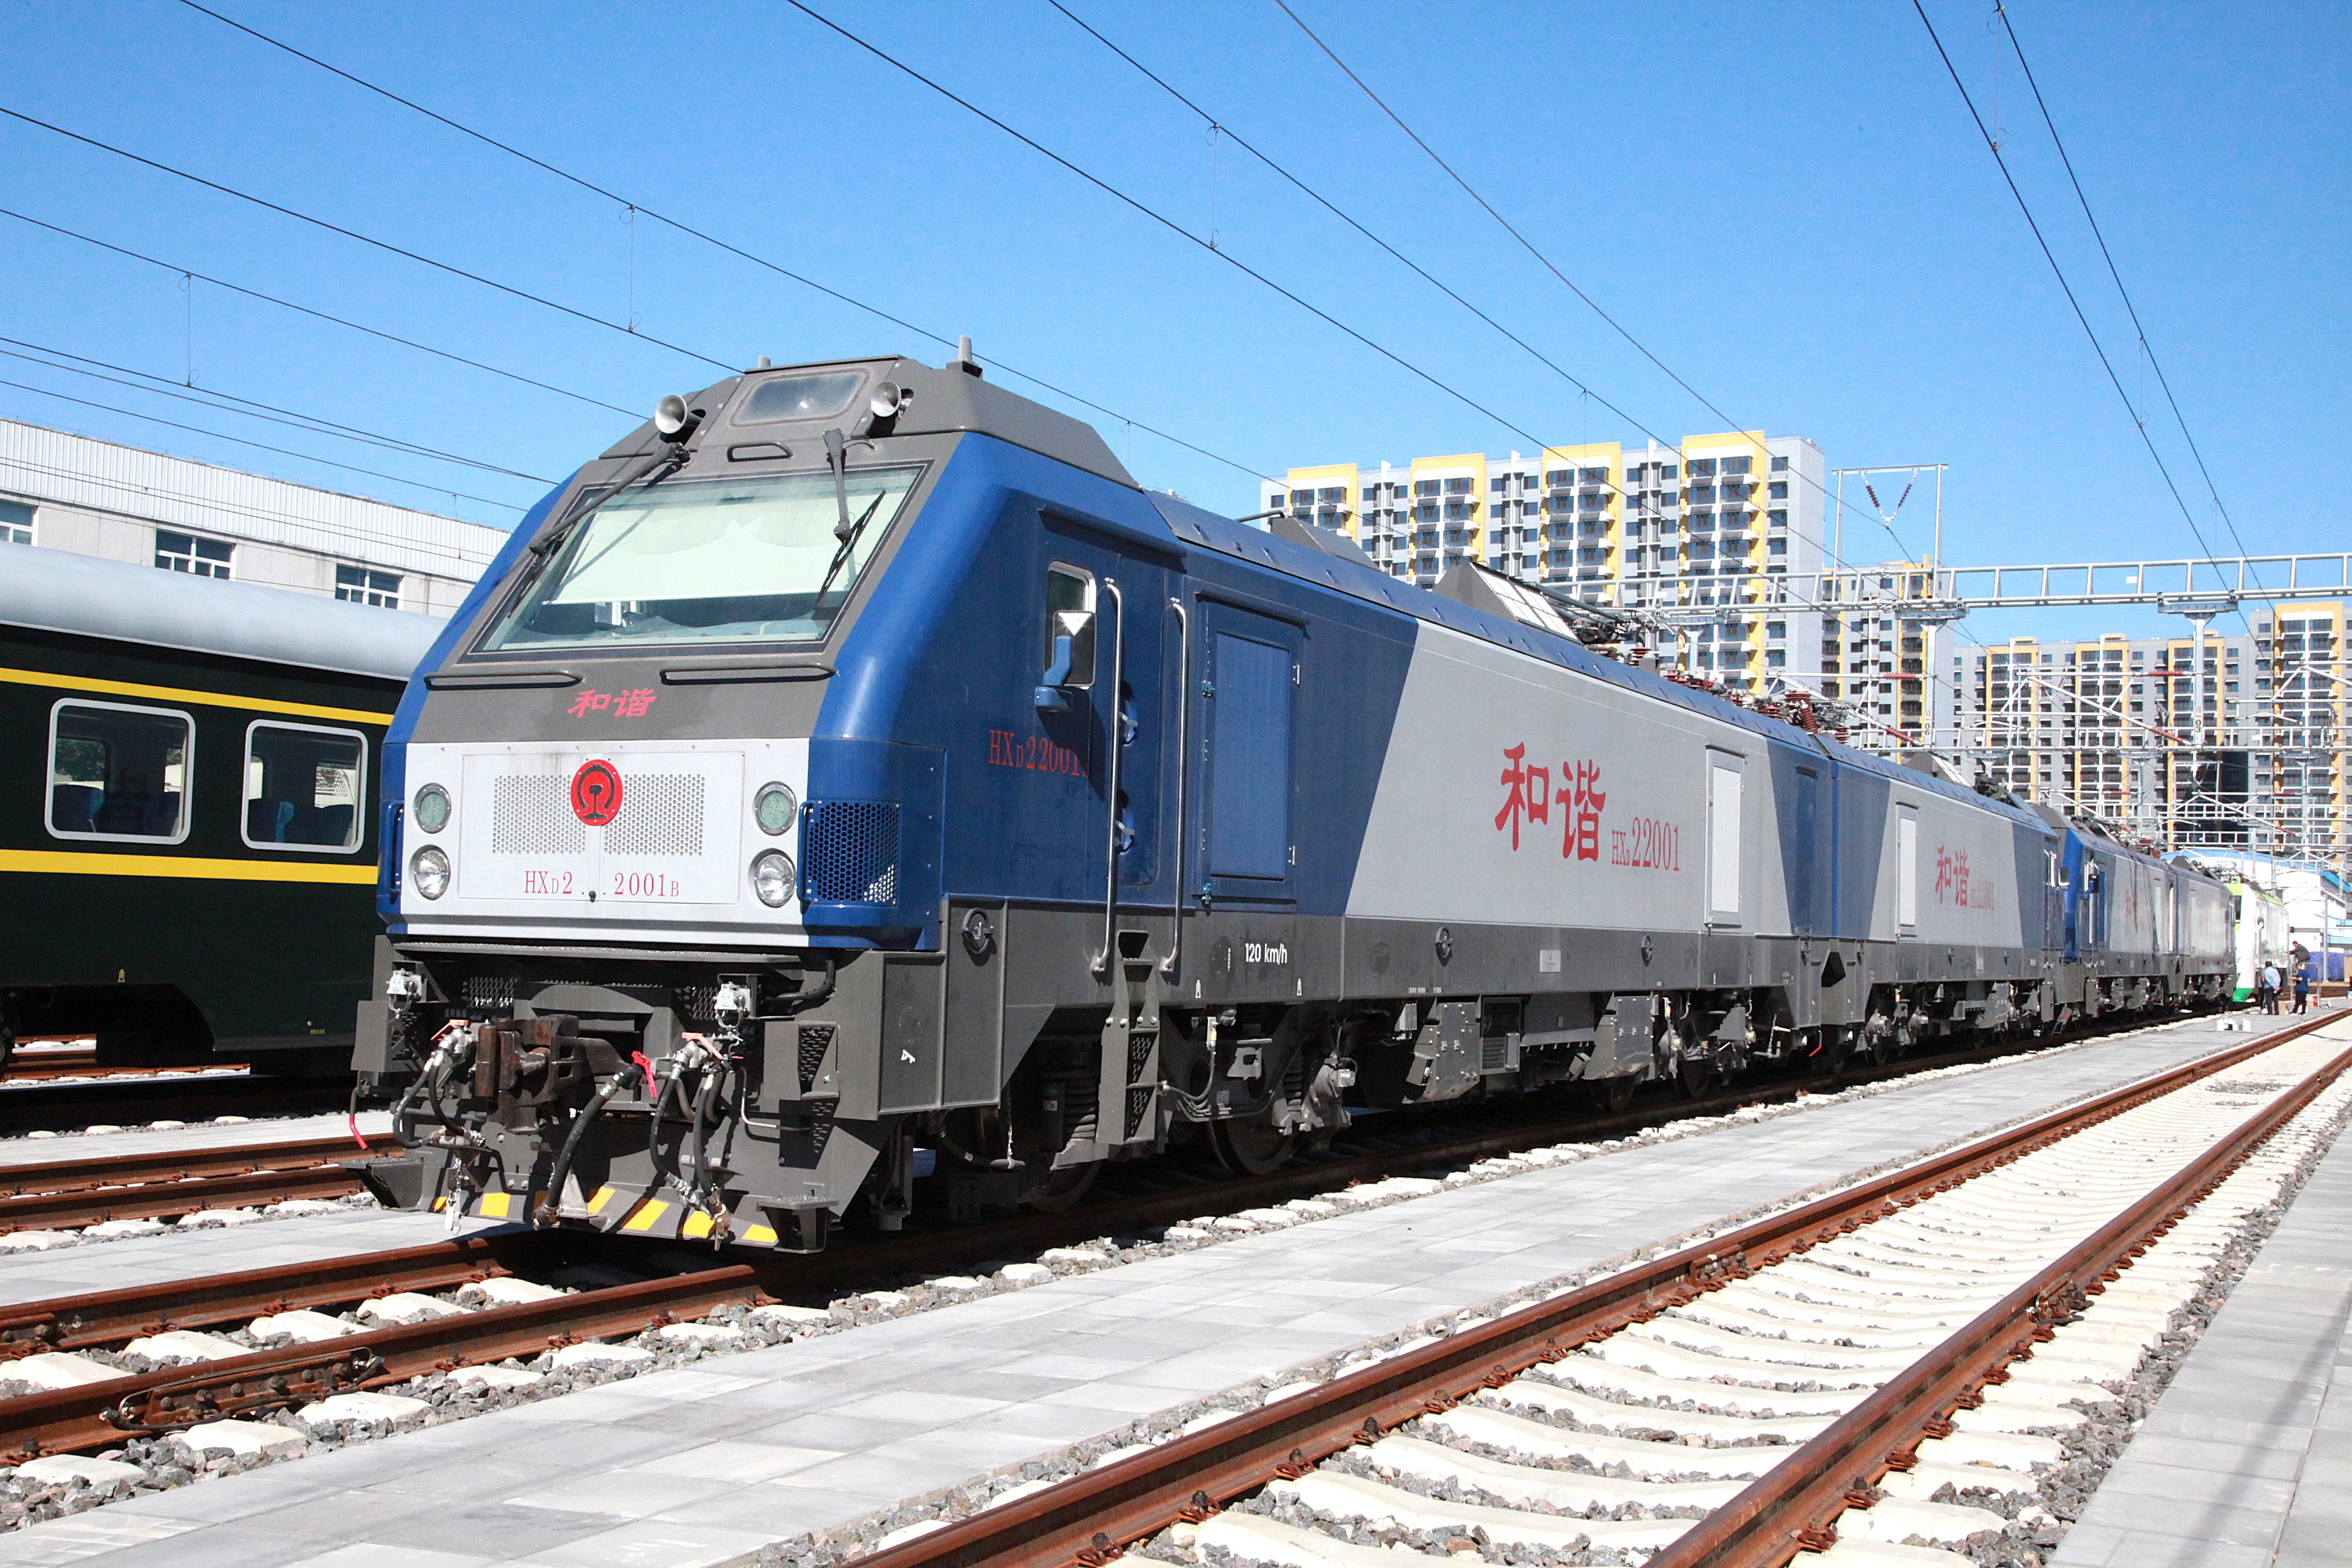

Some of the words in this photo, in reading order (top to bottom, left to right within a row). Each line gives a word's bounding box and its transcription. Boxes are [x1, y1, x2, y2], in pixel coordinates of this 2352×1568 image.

[567, 688, 658, 718] 和谐
[989, 729, 1088, 778] HXD22001
[1494, 741, 1606, 862] 和谐
[524, 870, 572, 894] HXD2
[614, 872, 679, 897] 2001B
[1935, 844, 1970, 907] 和谐
[1245, 943, 1261, 963] 120
[1264, 943, 1288, 965] km/h
